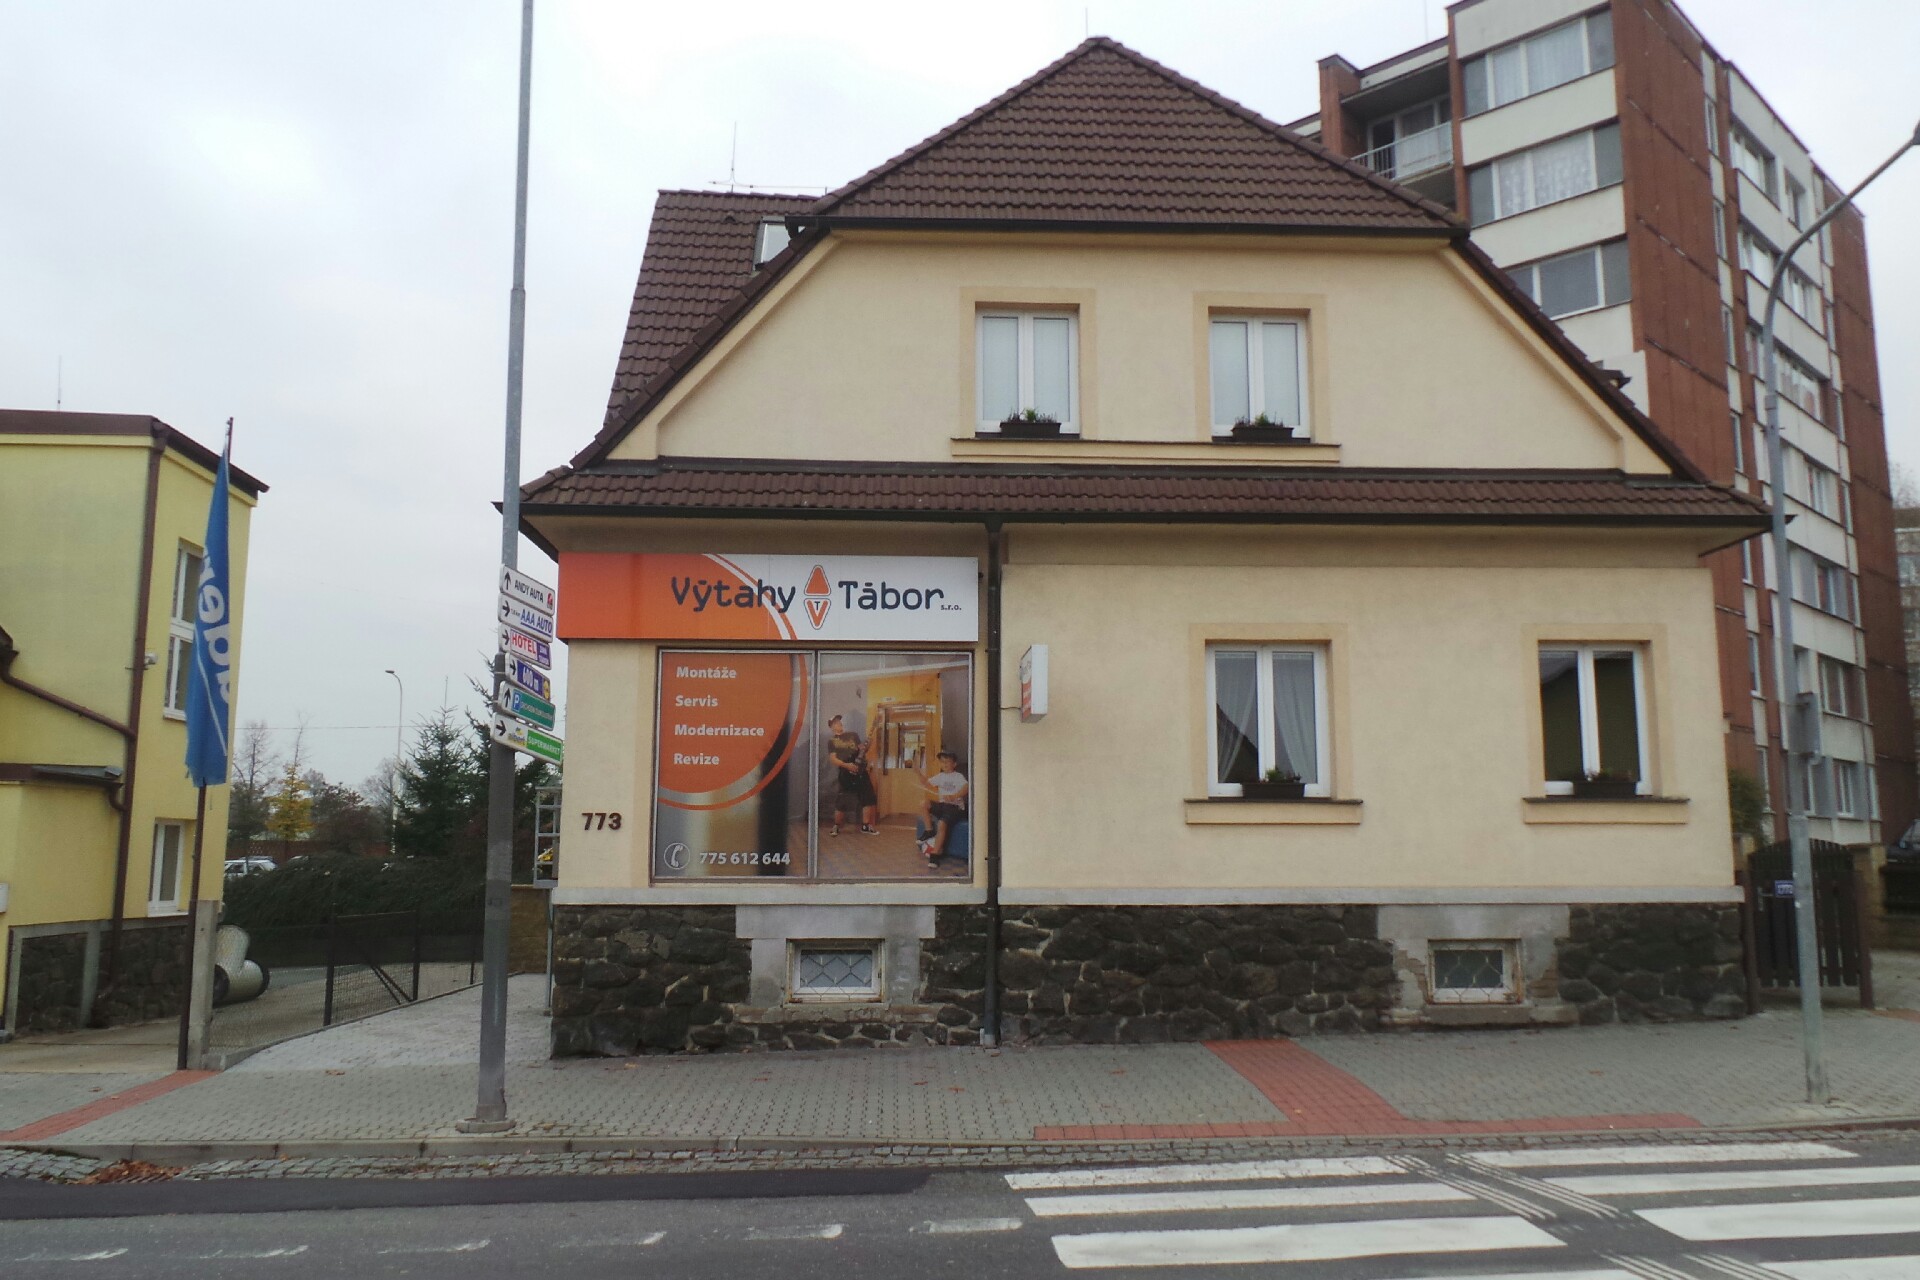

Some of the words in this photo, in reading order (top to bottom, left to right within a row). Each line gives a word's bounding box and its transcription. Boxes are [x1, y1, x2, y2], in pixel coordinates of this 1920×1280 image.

[514, 579, 530, 595] ANDY
[530, 587, 544, 603] AUTA
[671, 576, 796, 613] Výtahy
[838, 580, 945, 611] Tábor
[520, 608, 535, 625] AAA
[536, 616, 553, 633] AUTO
[511, 631, 537, 654] HOTEL
[676, 666, 737, 679] Montáže
[514, 694, 520, 708] P
[675, 694, 718, 707] Servis
[674, 724, 765, 736] Modernizace
[528, 735, 561, 755] SUPERMARKET
[673, 752, 720, 765] Revize
[581, 812, 623, 831] 773
[699, 852, 727, 865] 775
[730, 852, 759, 865] 612
[762, 852, 791, 865] 644
